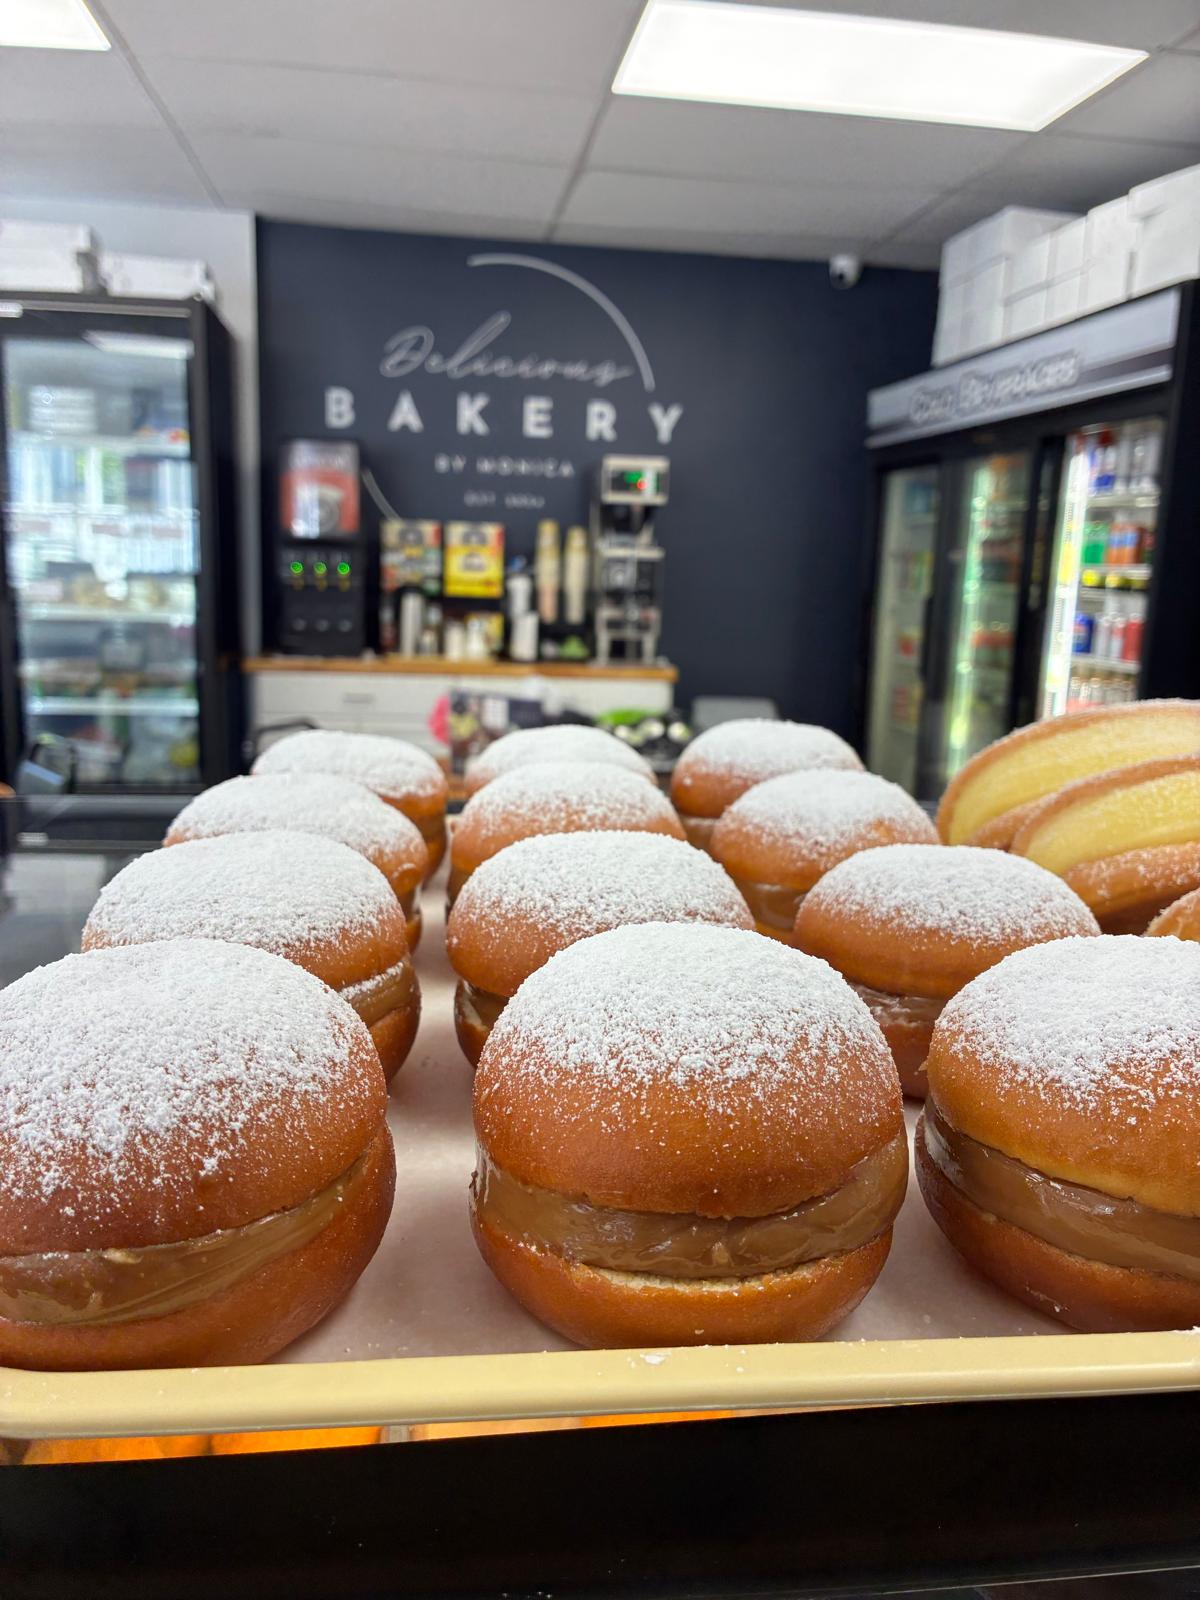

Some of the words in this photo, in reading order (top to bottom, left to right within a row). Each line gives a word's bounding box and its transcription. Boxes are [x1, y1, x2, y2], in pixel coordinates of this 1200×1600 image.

[380, 311, 635, 387] Delicious
[324, 386, 683, 444] BAKERY
[434, 453, 466, 474] BY
[476, 456, 574, 478] MONICA
